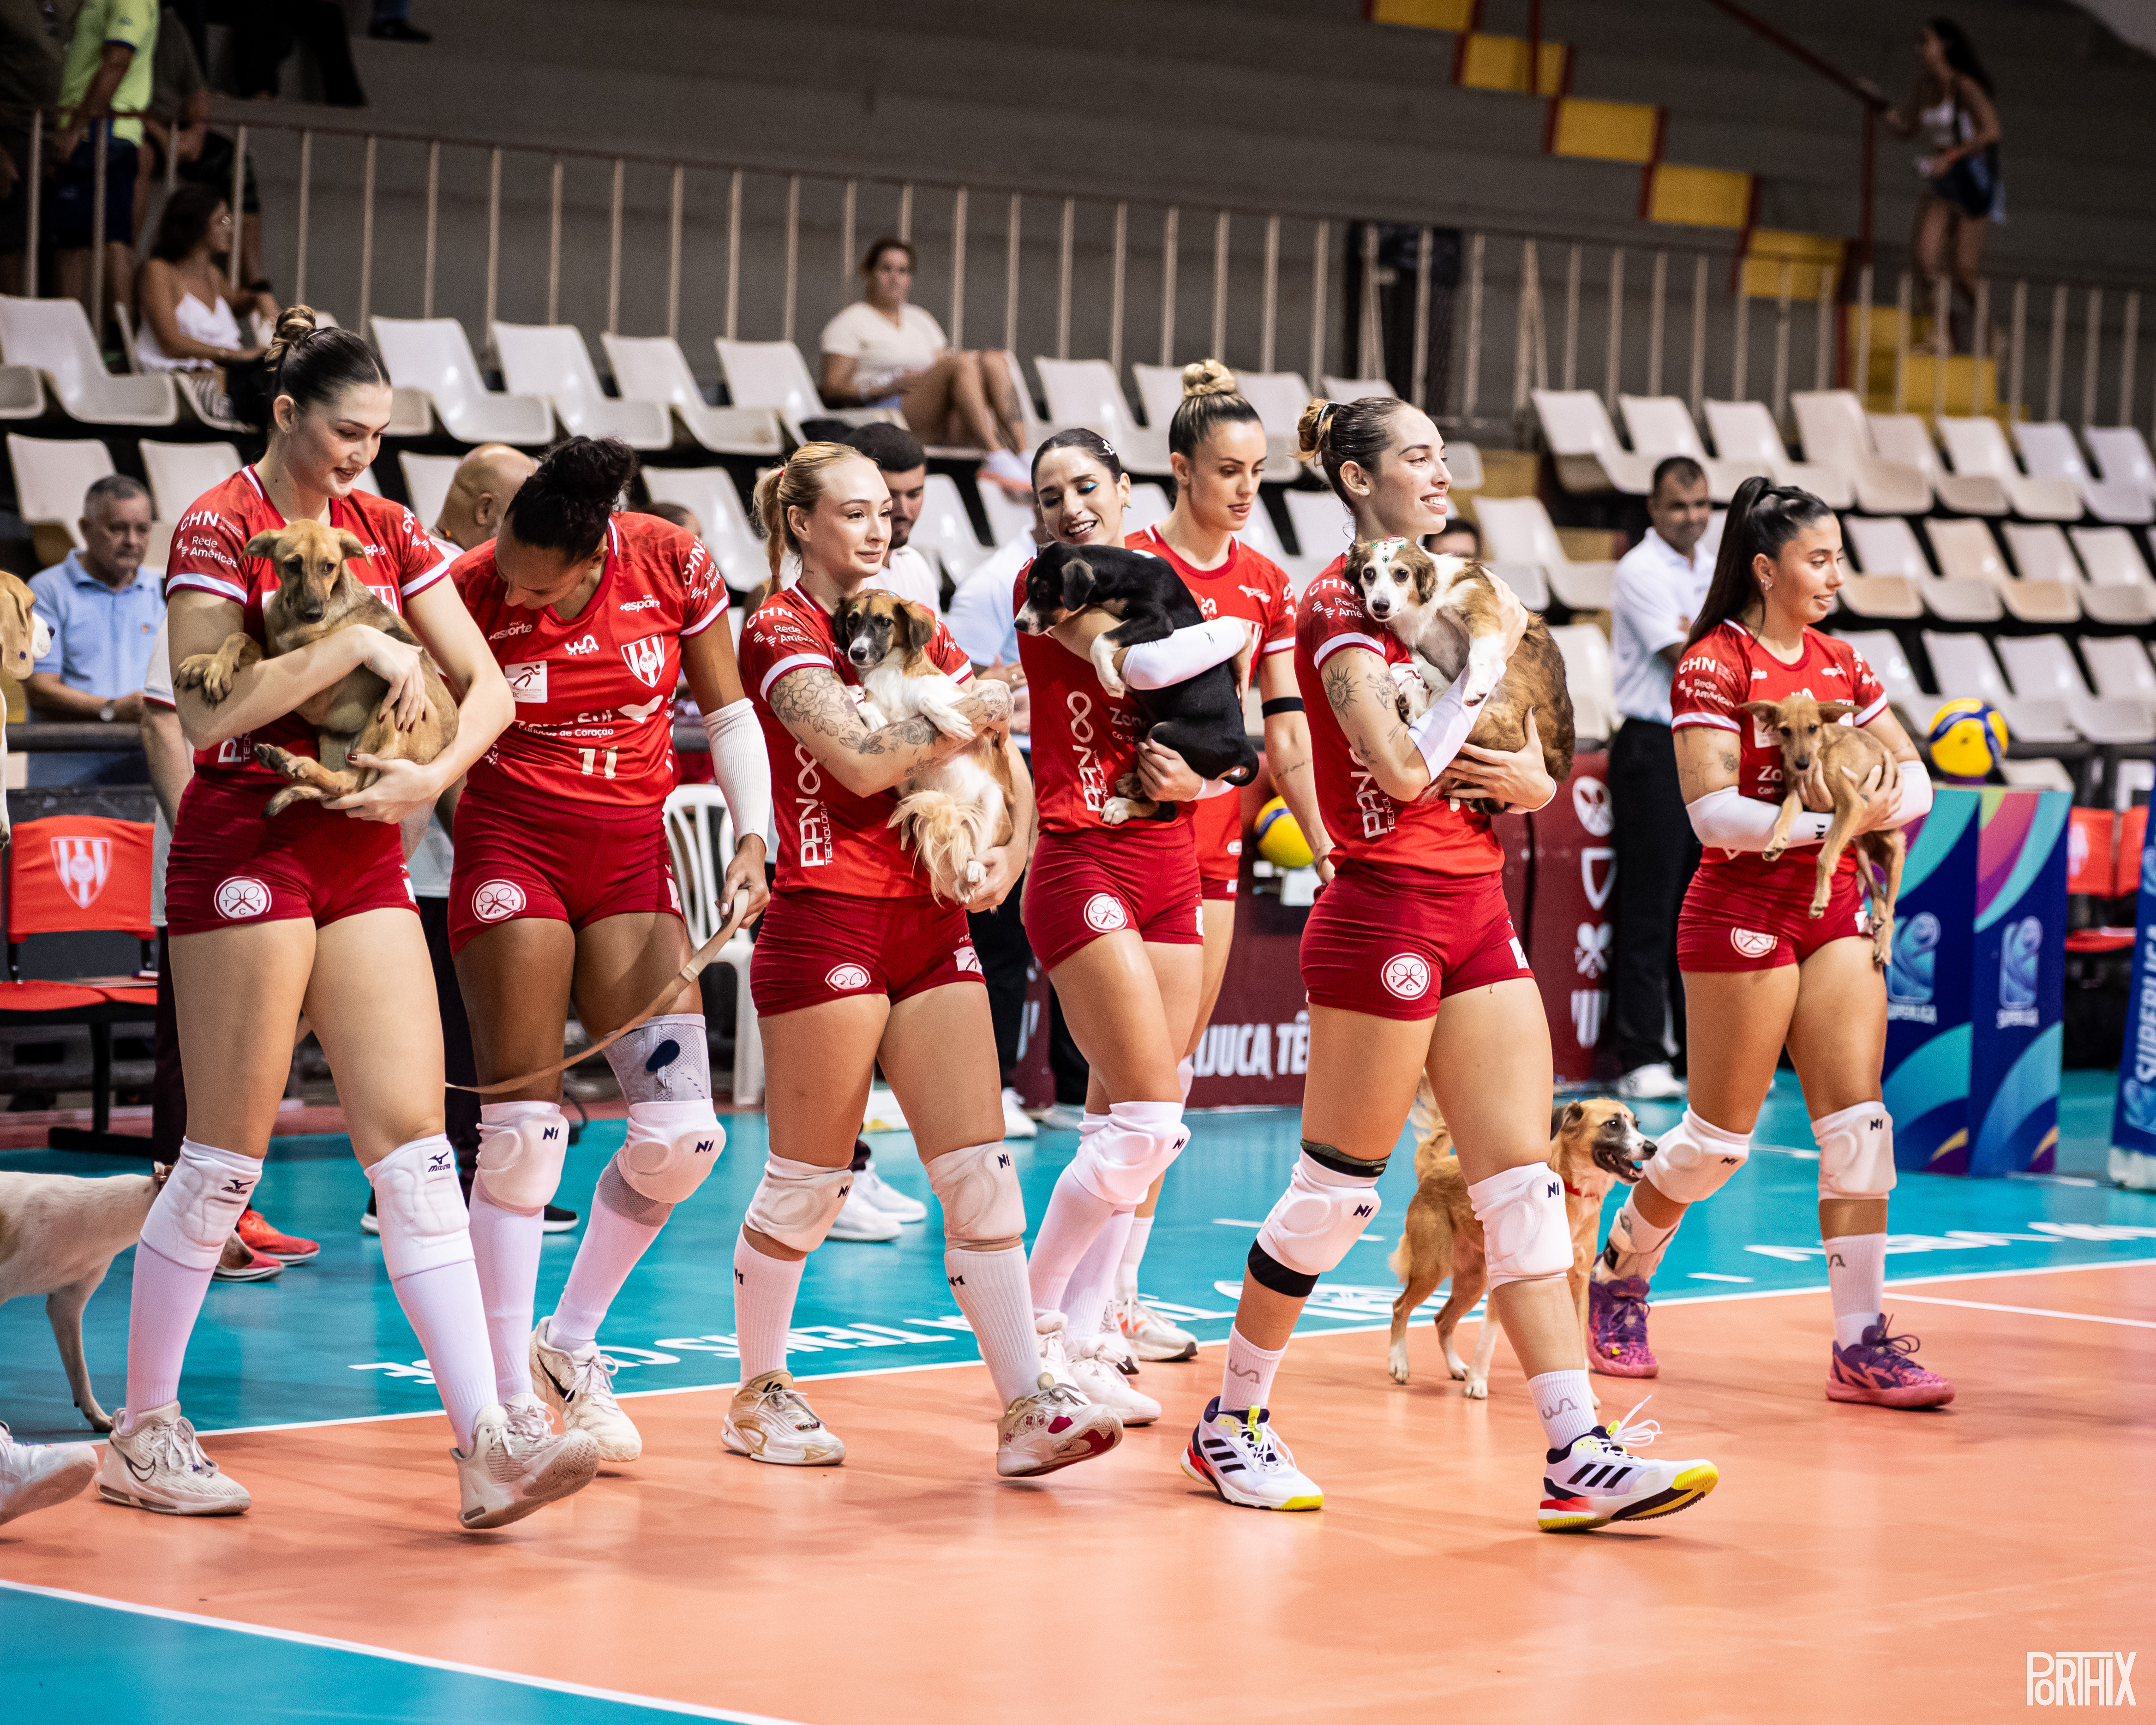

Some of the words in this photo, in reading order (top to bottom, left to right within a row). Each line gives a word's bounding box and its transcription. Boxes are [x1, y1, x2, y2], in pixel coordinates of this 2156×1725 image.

[180, 510, 219, 531] CHN
[192, 536, 218, 548] Rede
[190, 547, 237, 568] Américas
[683, 541, 706, 586] CHN
[1309, 578, 1355, 596] CHN
[746, 607, 793, 629] CHN
[773, 625, 801, 634] Rede
[1679, 657, 1716, 674] CHN
[575, 727, 614, 738] Coração
[578, 746, 618, 779] 11
[796, 798, 825, 867] PPN
[820, 801, 832, 866] TECNOLOGIA
